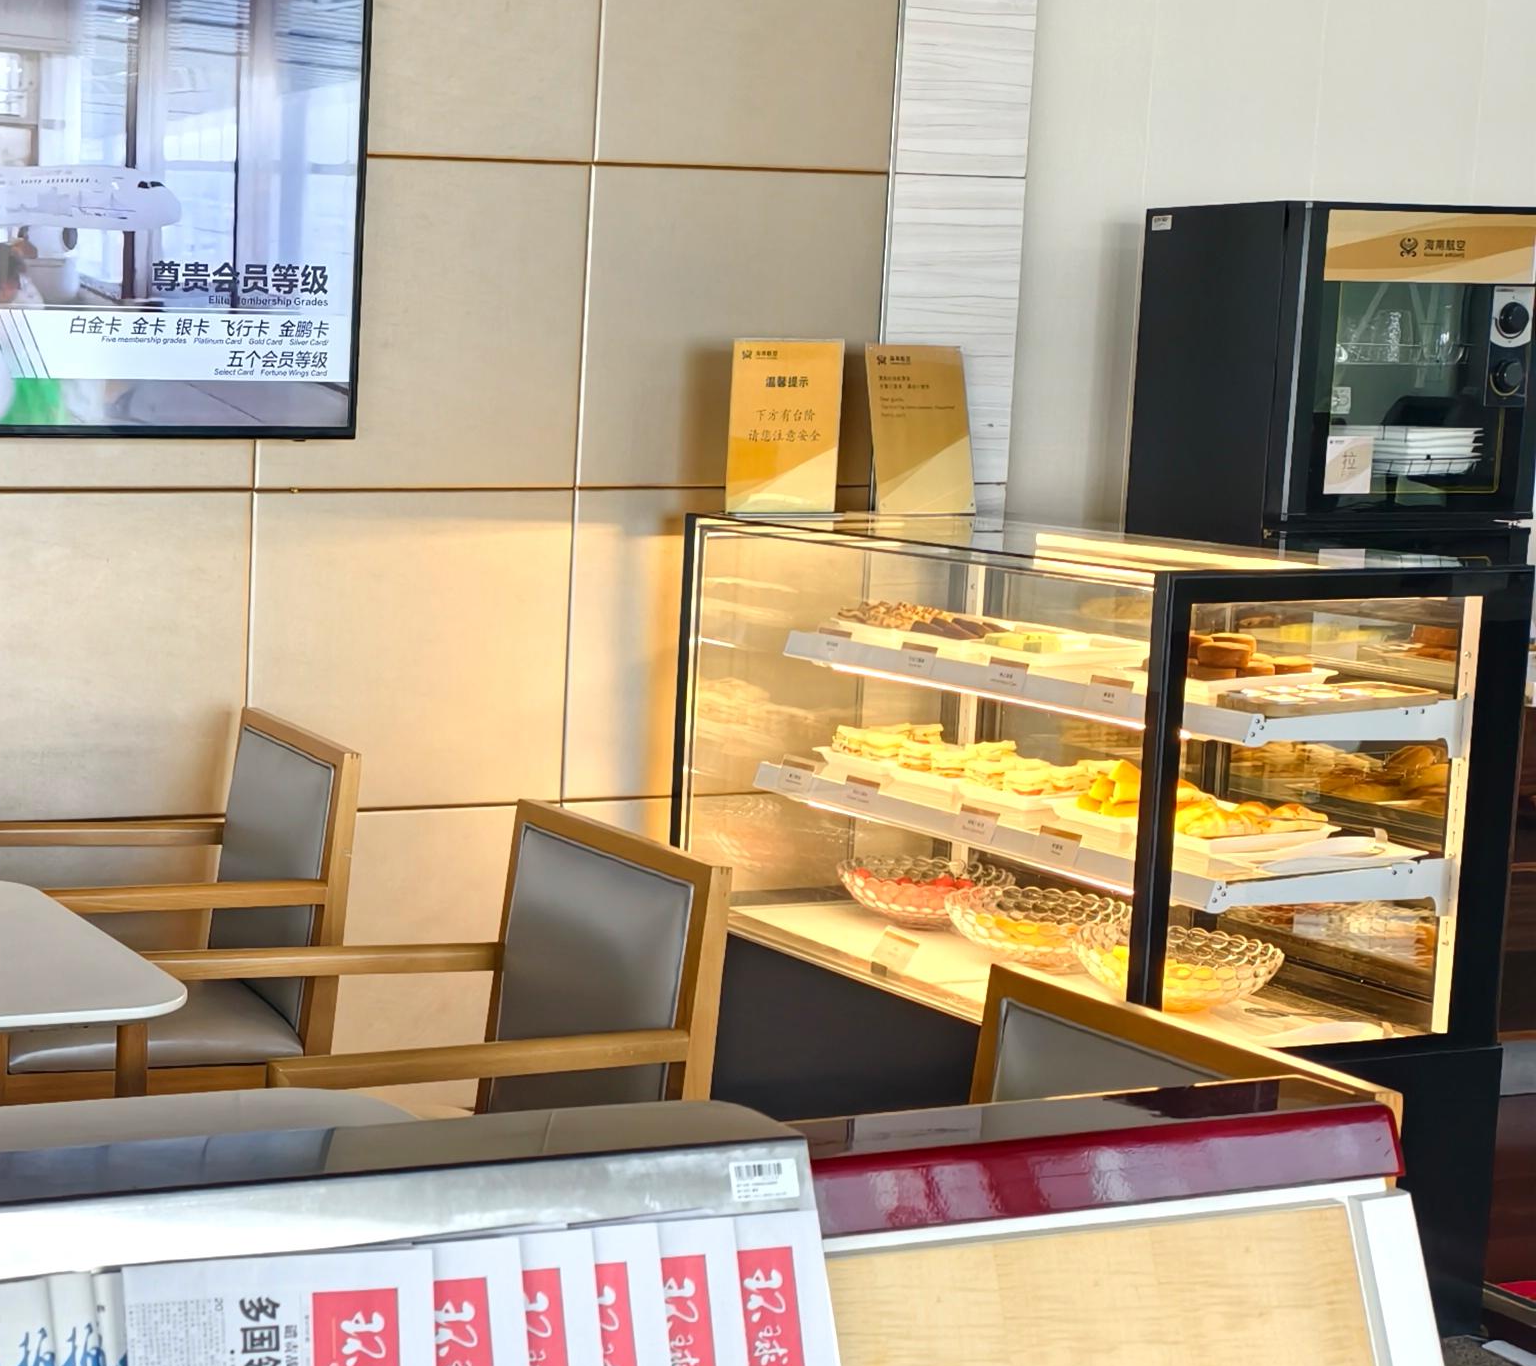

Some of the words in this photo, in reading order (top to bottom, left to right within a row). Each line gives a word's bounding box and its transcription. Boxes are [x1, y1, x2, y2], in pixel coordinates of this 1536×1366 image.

[152, 261, 329, 295] 尊贵会员等级
[209, 296, 230, 306] Elite
[232, 296, 292, 309] embership
[293, 297, 329, 308] Grades
[69, 316, 120, 336] 白金卡
[130, 317, 166, 336] 金卡
[175, 317, 210, 336] 银卡
[220, 319, 270, 337] 飞行卡
[279, 320, 330, 338] 金鹏卡
[101, 336, 116, 344] Five
[117, 337, 161, 346] membership
[162, 338, 187, 346] grades
[193, 337, 224, 346] Platinum
[225, 338, 243, 346] Card
[248, 338, 265, 346] Gold
[266, 339, 283, 347] Card
[289, 338, 311, 347] Silver
[226, 350, 329, 369] 五个会员等级
[214, 368, 236, 377] Select
[237, 369, 254, 377] Card
[260, 369, 288, 378] Fortune
[289, 370, 310, 379] Wings
[311, 370, 328, 378] Card
[765, 376, 809, 388] 温馨提示
[755, 408, 816, 424] 下方有台阶
[748, 428, 822, 443] 请您注意安全
